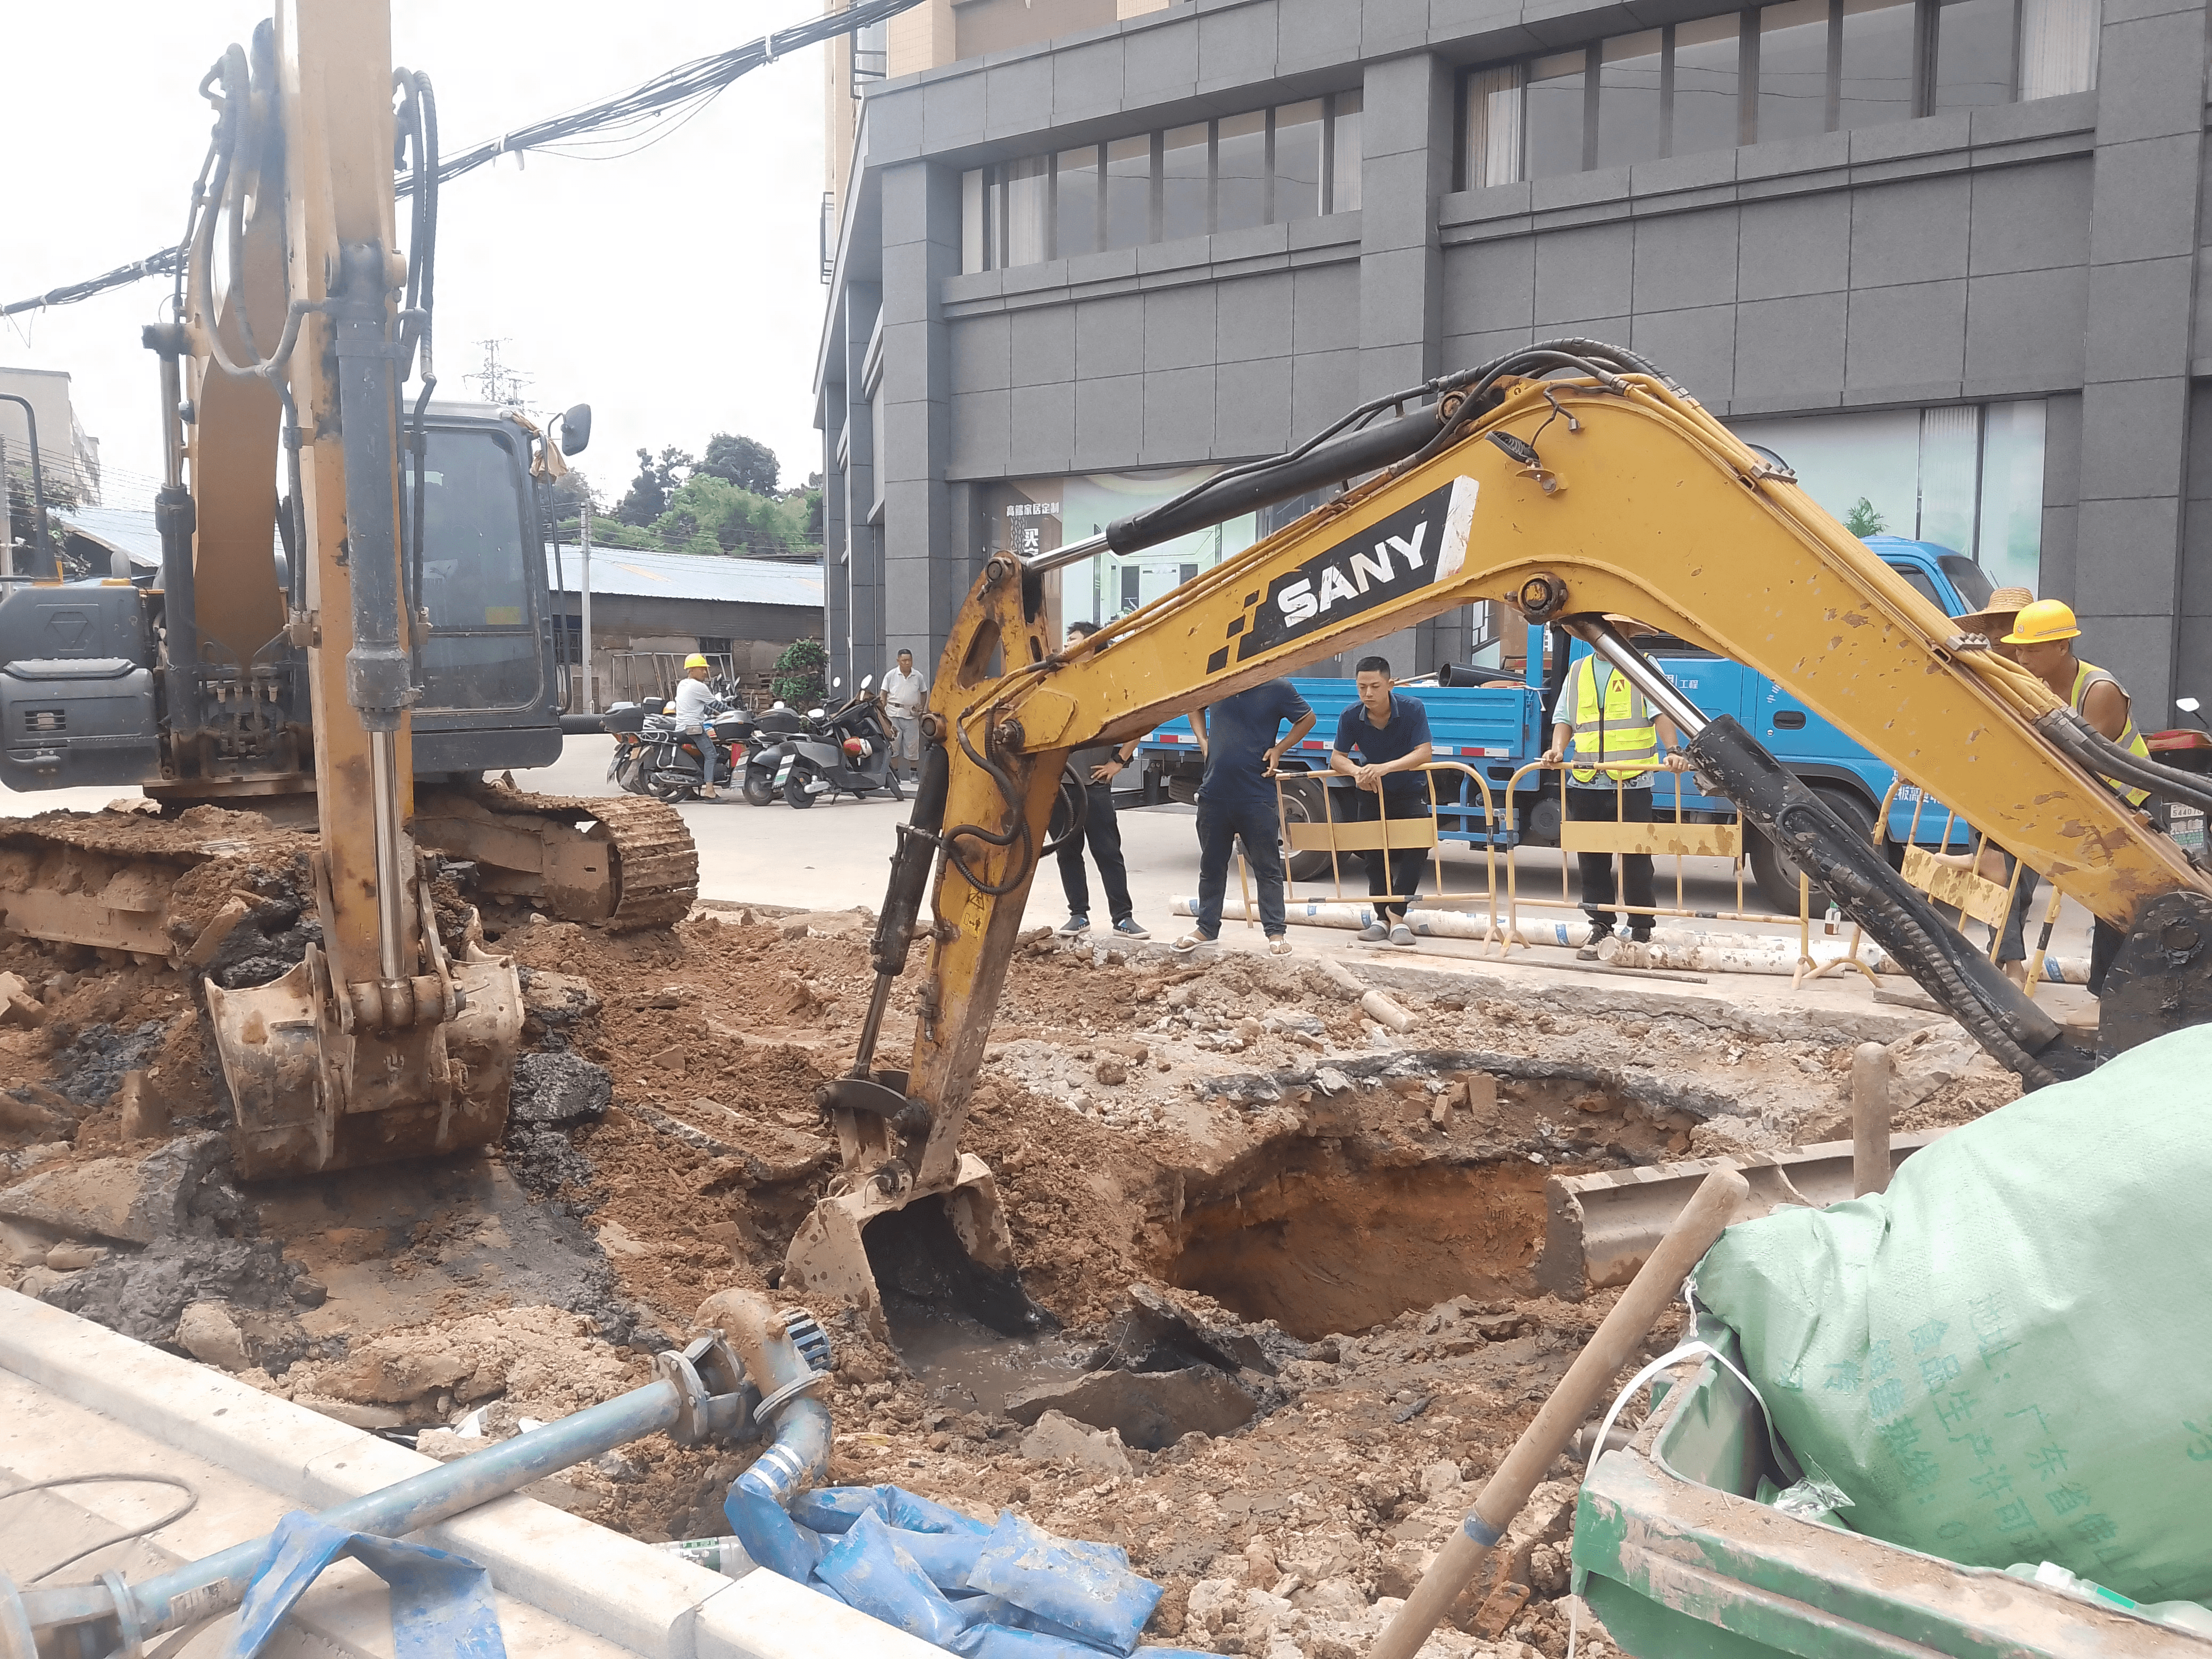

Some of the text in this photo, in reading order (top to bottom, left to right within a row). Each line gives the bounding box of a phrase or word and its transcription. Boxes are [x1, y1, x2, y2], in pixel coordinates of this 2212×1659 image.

[1006, 502, 1059, 517] 高端家居定制
[1277, 520, 1429, 629] SANY
[1679, 679, 1699, 690] 工程
